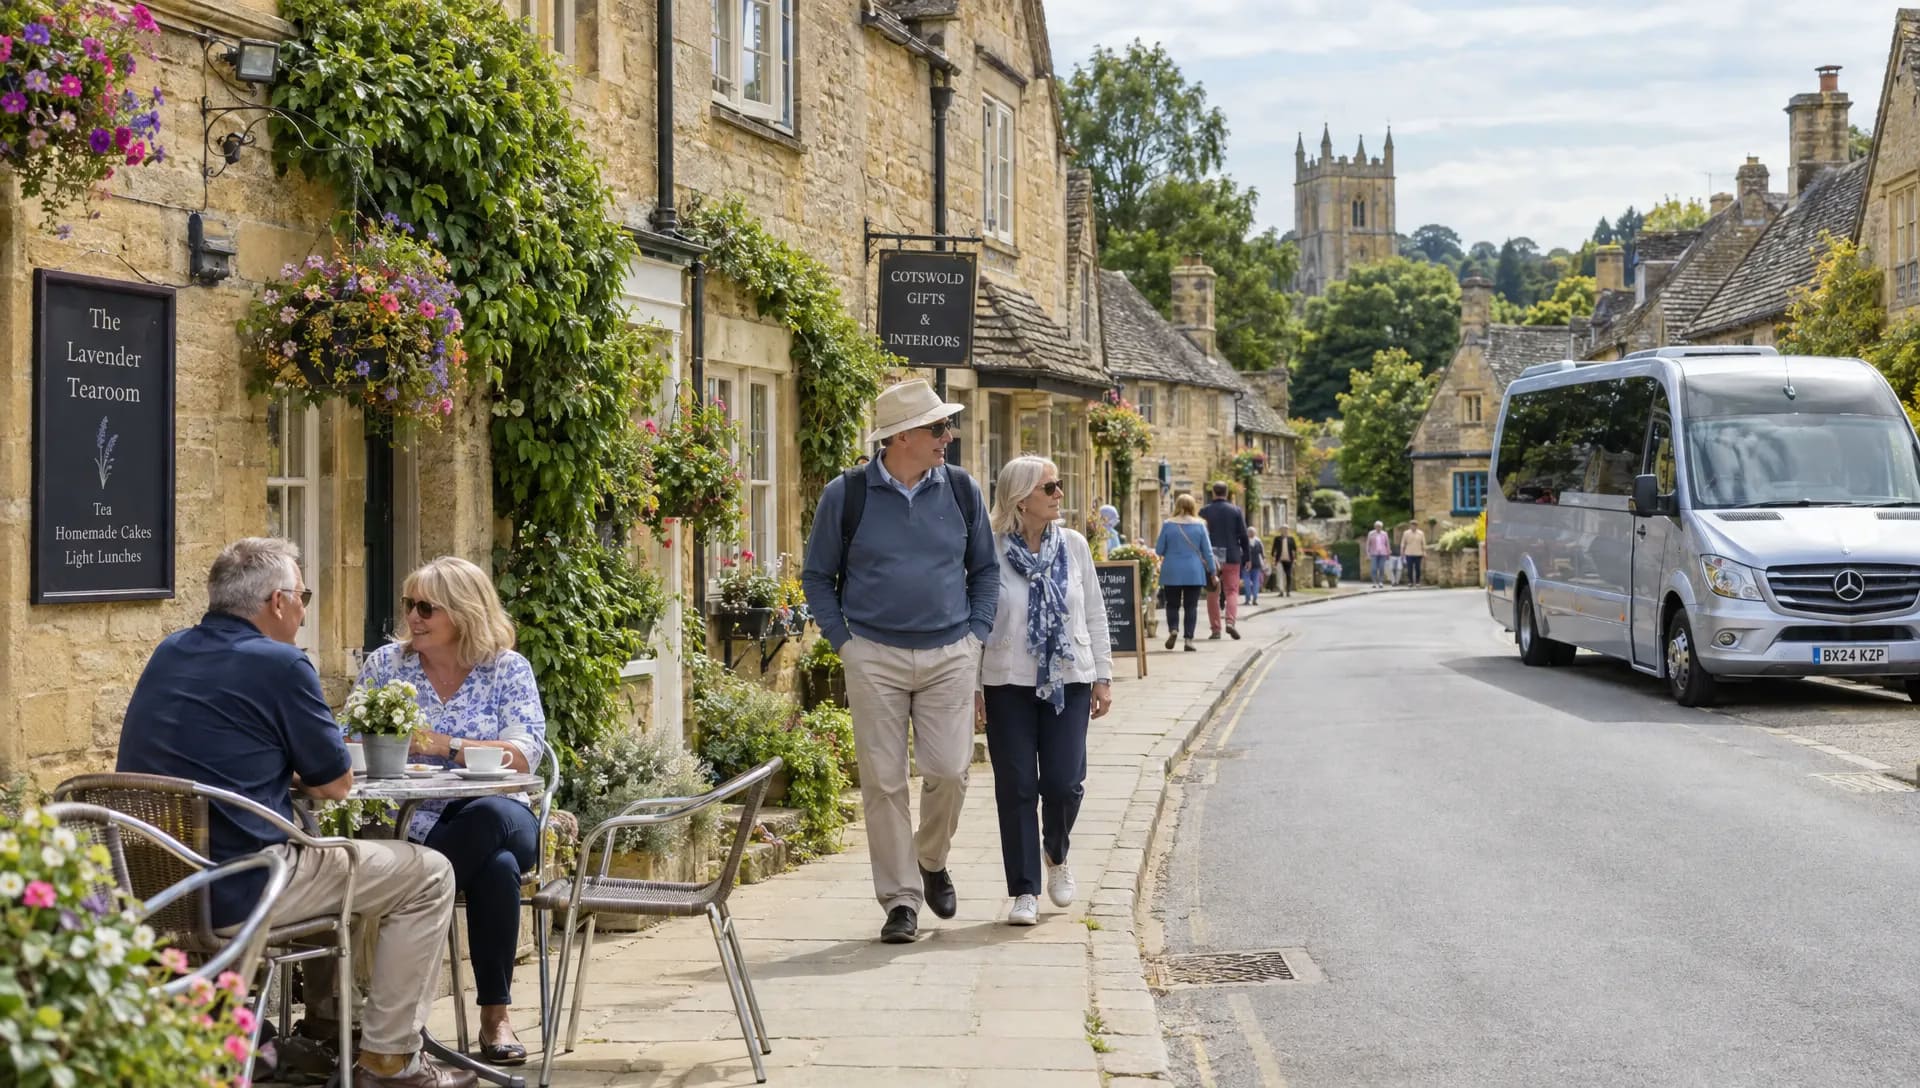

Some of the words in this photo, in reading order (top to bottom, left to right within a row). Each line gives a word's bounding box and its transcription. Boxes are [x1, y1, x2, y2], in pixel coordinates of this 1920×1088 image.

[891, 271, 964, 284] COTSWOLD
[907, 292, 945, 304] GIFTS
[90, 308, 121, 331] The
[920, 314, 930, 325] &
[889, 333, 960, 347] INTERIORS
[66, 341, 142, 368] Lavender
[67, 377, 141, 403] Tearoom
[93, 502, 112, 516] Tea
[55, 525, 117, 540] Homemade
[121, 524, 152, 539] Cakes
[65, 549, 93, 568] Light
[98, 548, 142, 563] Lunches
[1823, 649, 1856, 662] BX24
[1859, 649, 1884, 662] KZP
